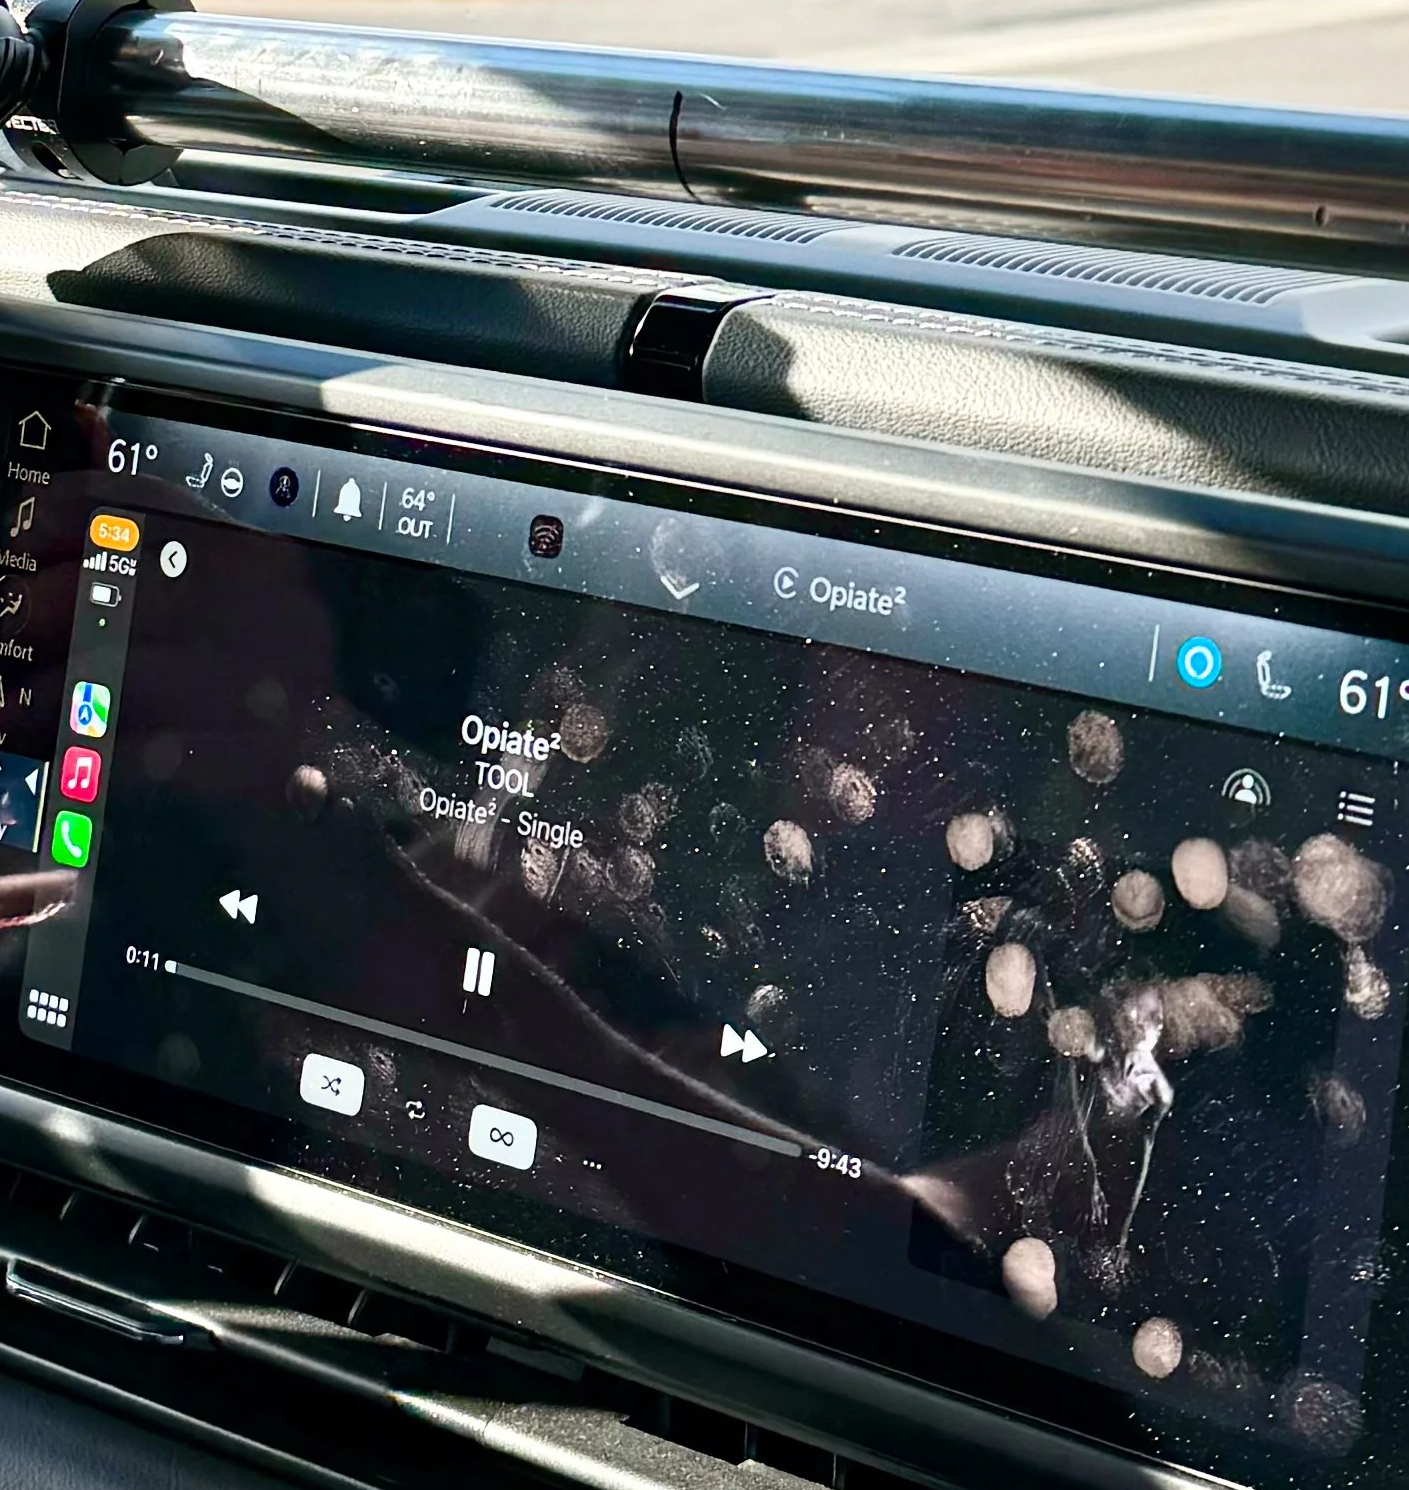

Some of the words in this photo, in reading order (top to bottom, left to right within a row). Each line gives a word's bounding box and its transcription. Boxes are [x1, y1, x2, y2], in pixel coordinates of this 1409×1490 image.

[107, 438, 159, 476] 61°
[7, 461, 51, 485] Home
[401, 487, 435, 512] 64°
[98, 522, 130, 543] 5:34
[397, 516, 434, 539] OUT
[18, 686, 33, 707] N
[474, 760, 535, 798] TOOL
[516, 810, 584, 849] Single
[125, 945, 160, 971] 0:11
[807, 1148, 863, 1180] -9:43
